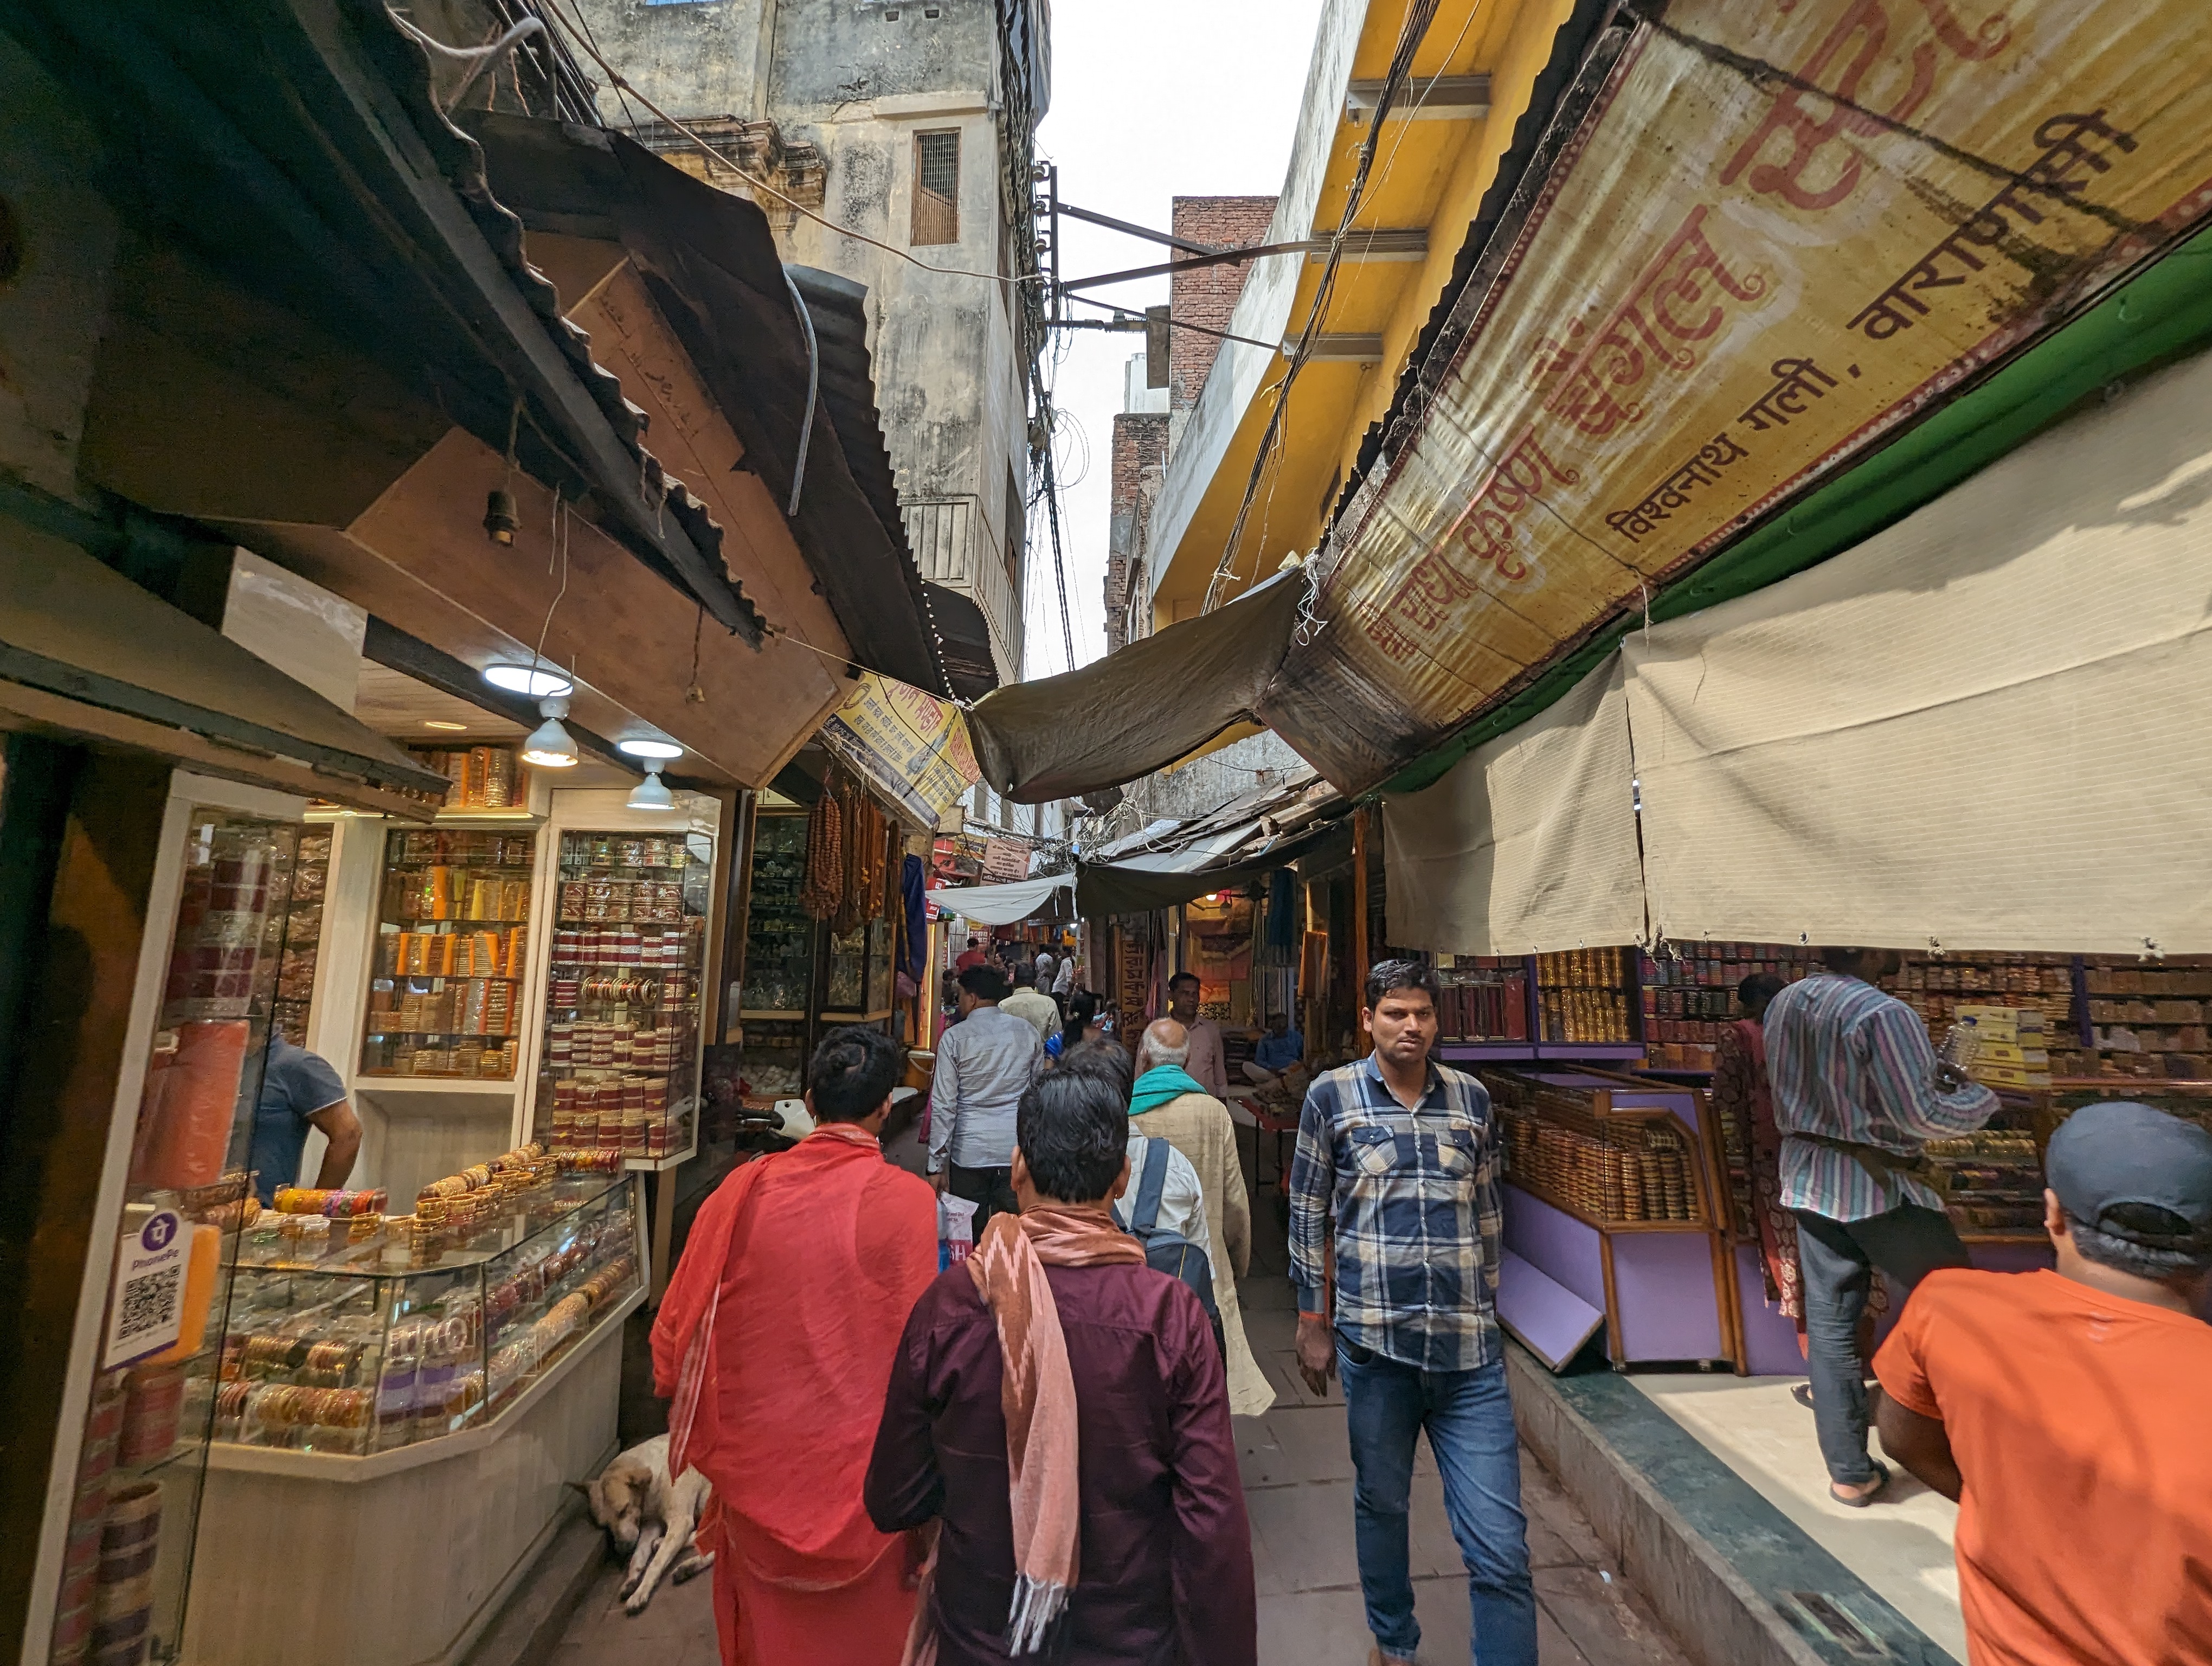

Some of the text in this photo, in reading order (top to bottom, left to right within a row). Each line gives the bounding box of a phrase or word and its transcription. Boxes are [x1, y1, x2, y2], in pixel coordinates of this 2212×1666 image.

[1604, 427, 1748, 543] विश्वनाथ
[1846, 108, 2138, 340] वाराणसी
[1390, 544, 1479, 631] राधा
[1444, 423, 1580, 580] कृष्ण
